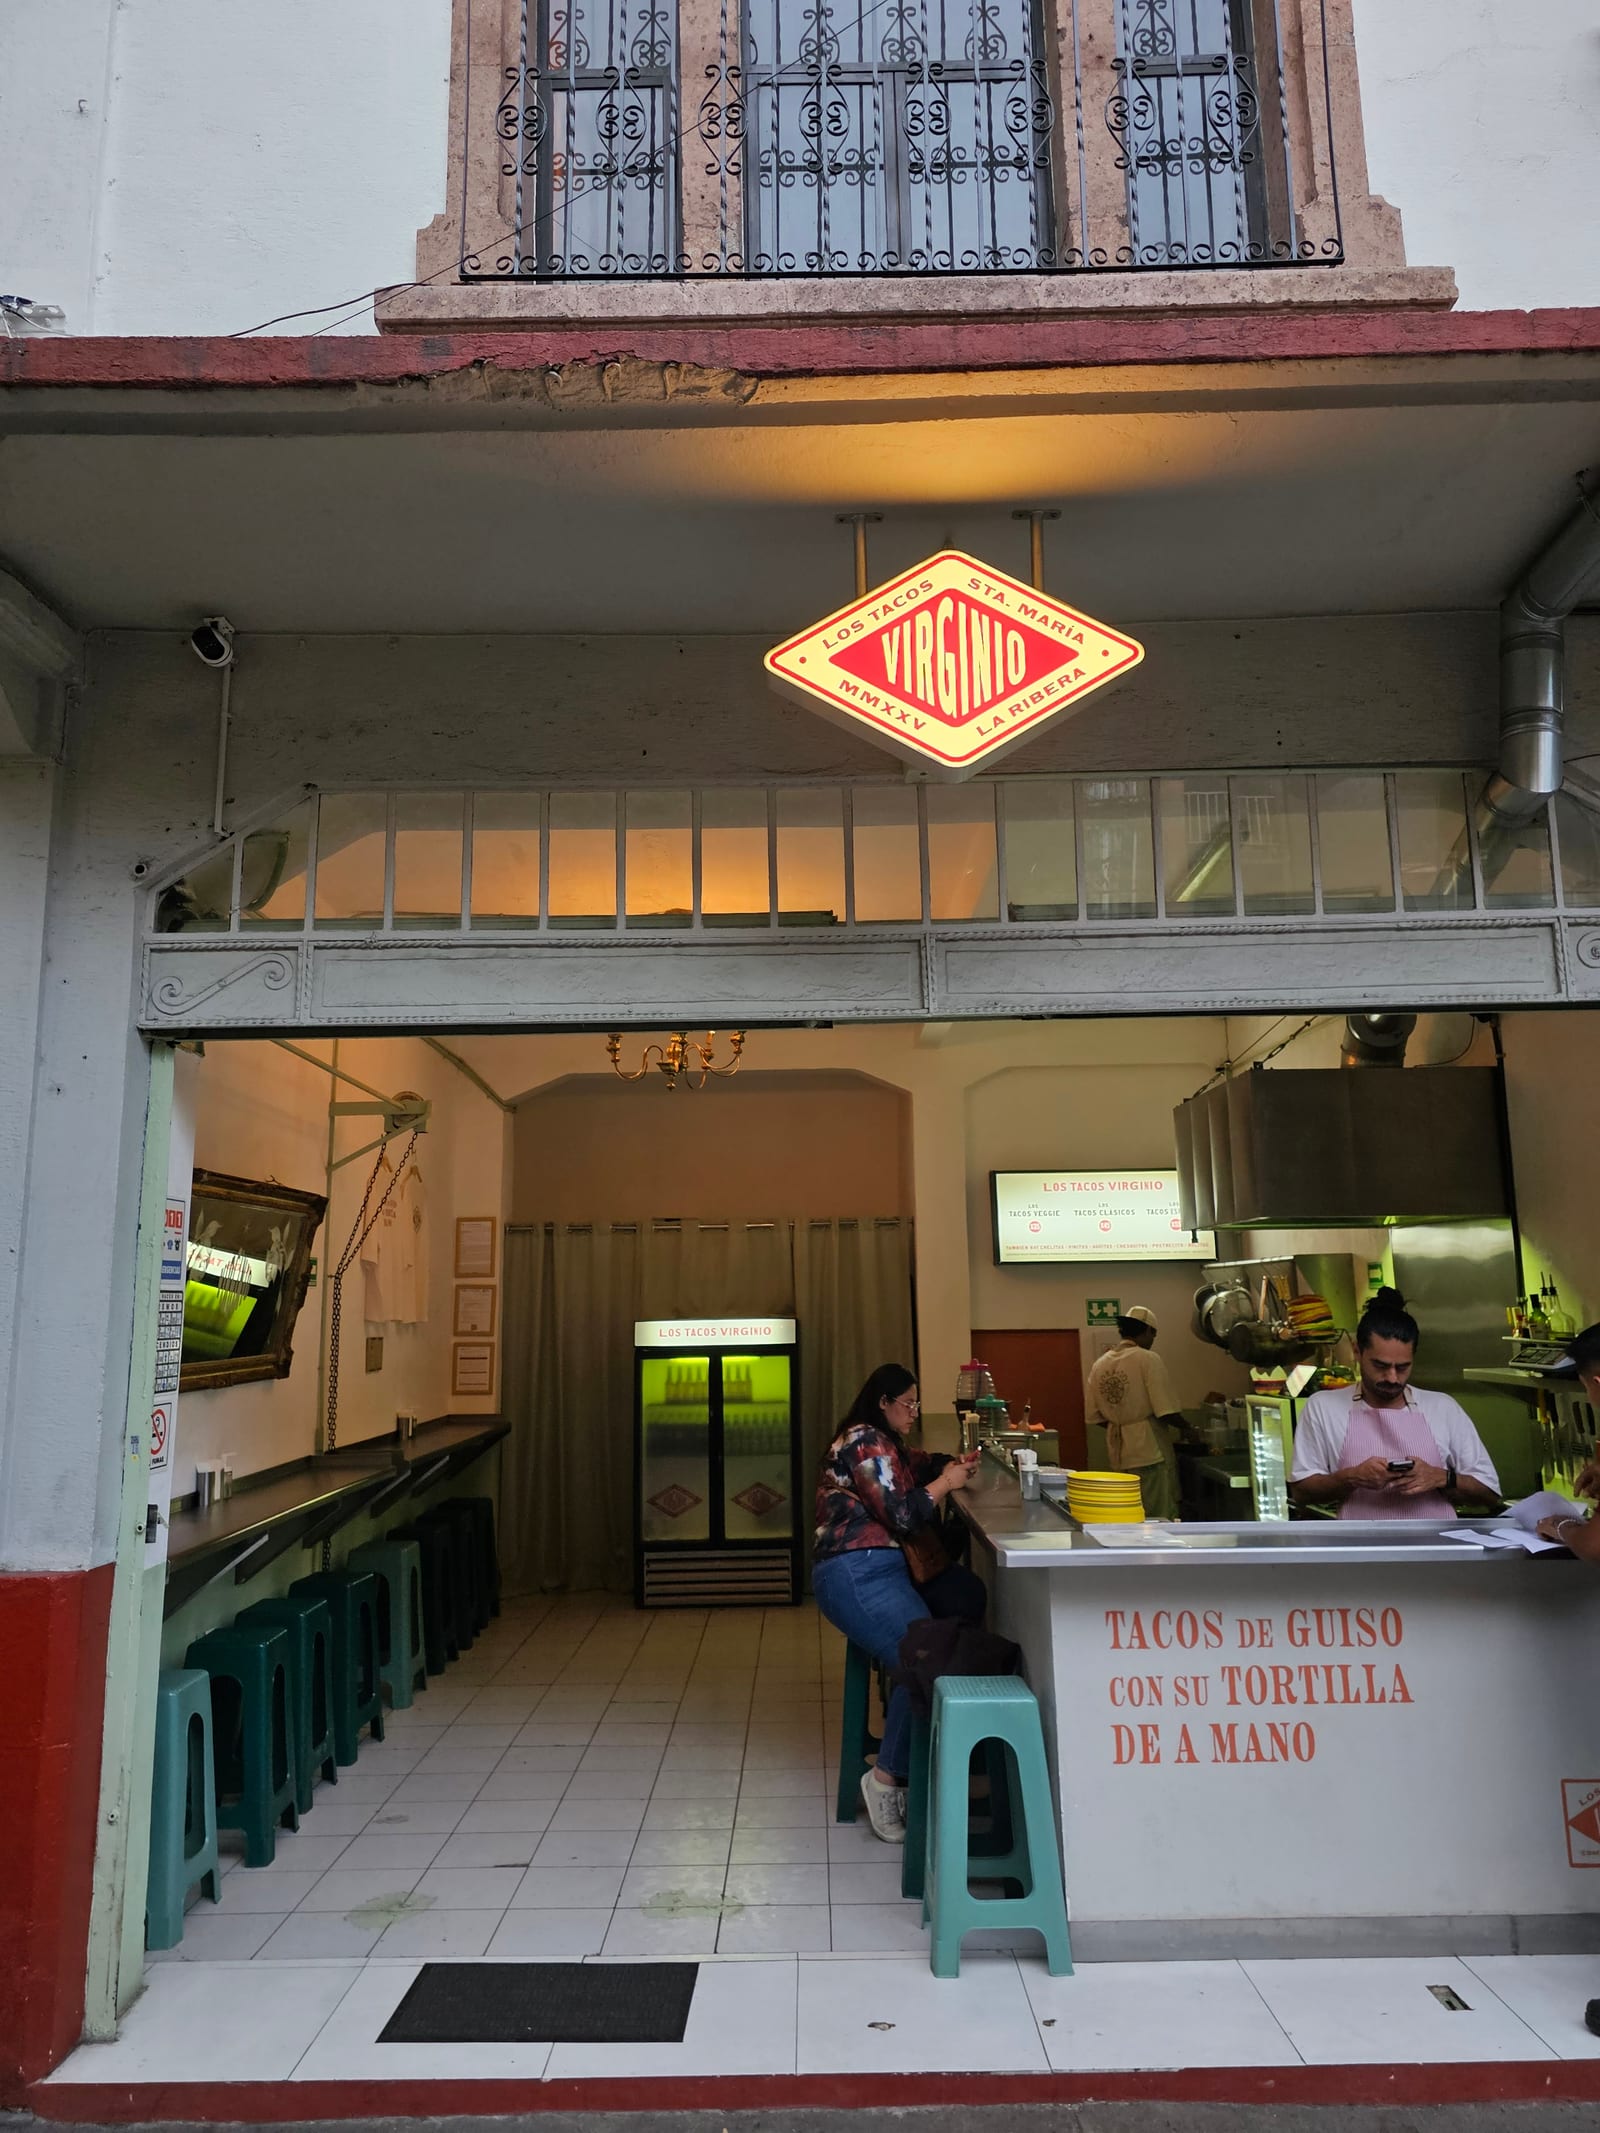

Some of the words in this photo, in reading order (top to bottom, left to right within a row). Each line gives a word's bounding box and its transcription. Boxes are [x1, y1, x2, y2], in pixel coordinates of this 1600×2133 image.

[822, 621, 865, 650] LOS
[867, 579, 935, 623] TACOS
[967, 576, 1011, 608] STA.
[1017, 601, 1087, 645] MARÍA
[880, 596, 1027, 719] VIRGINIO
[838, 679, 927, 732] MMXXV
[976, 715, 1006, 737] LA
[1010, 667, 1087, 718] RIBERA
[1043, 1182, 1067, 1192] LOS
[1071, 1182, 1105, 1192] TACOS
[1108, 1181, 1163, 1191] VIRGINIO
[659, 1327, 681, 1338] LOS
[685, 1327, 717, 1337] TACOS
[720, 1327, 772, 1337] VIRGINIO
[1104, 1609, 1224, 1650] TACOS
[1236, 1618, 1274, 1649] DE
[1287, 1607, 1403, 1648] GUISO
[1109, 1675, 1164, 1707] CON
[1173, 1675, 1210, 1707] SU
[1220, 1663, 1415, 1706] TORTILLA
[1110, 1723, 1161, 1765] DE
[1174, 1723, 1201, 1764] A
[1208, 1721, 1316, 1763] MANO
